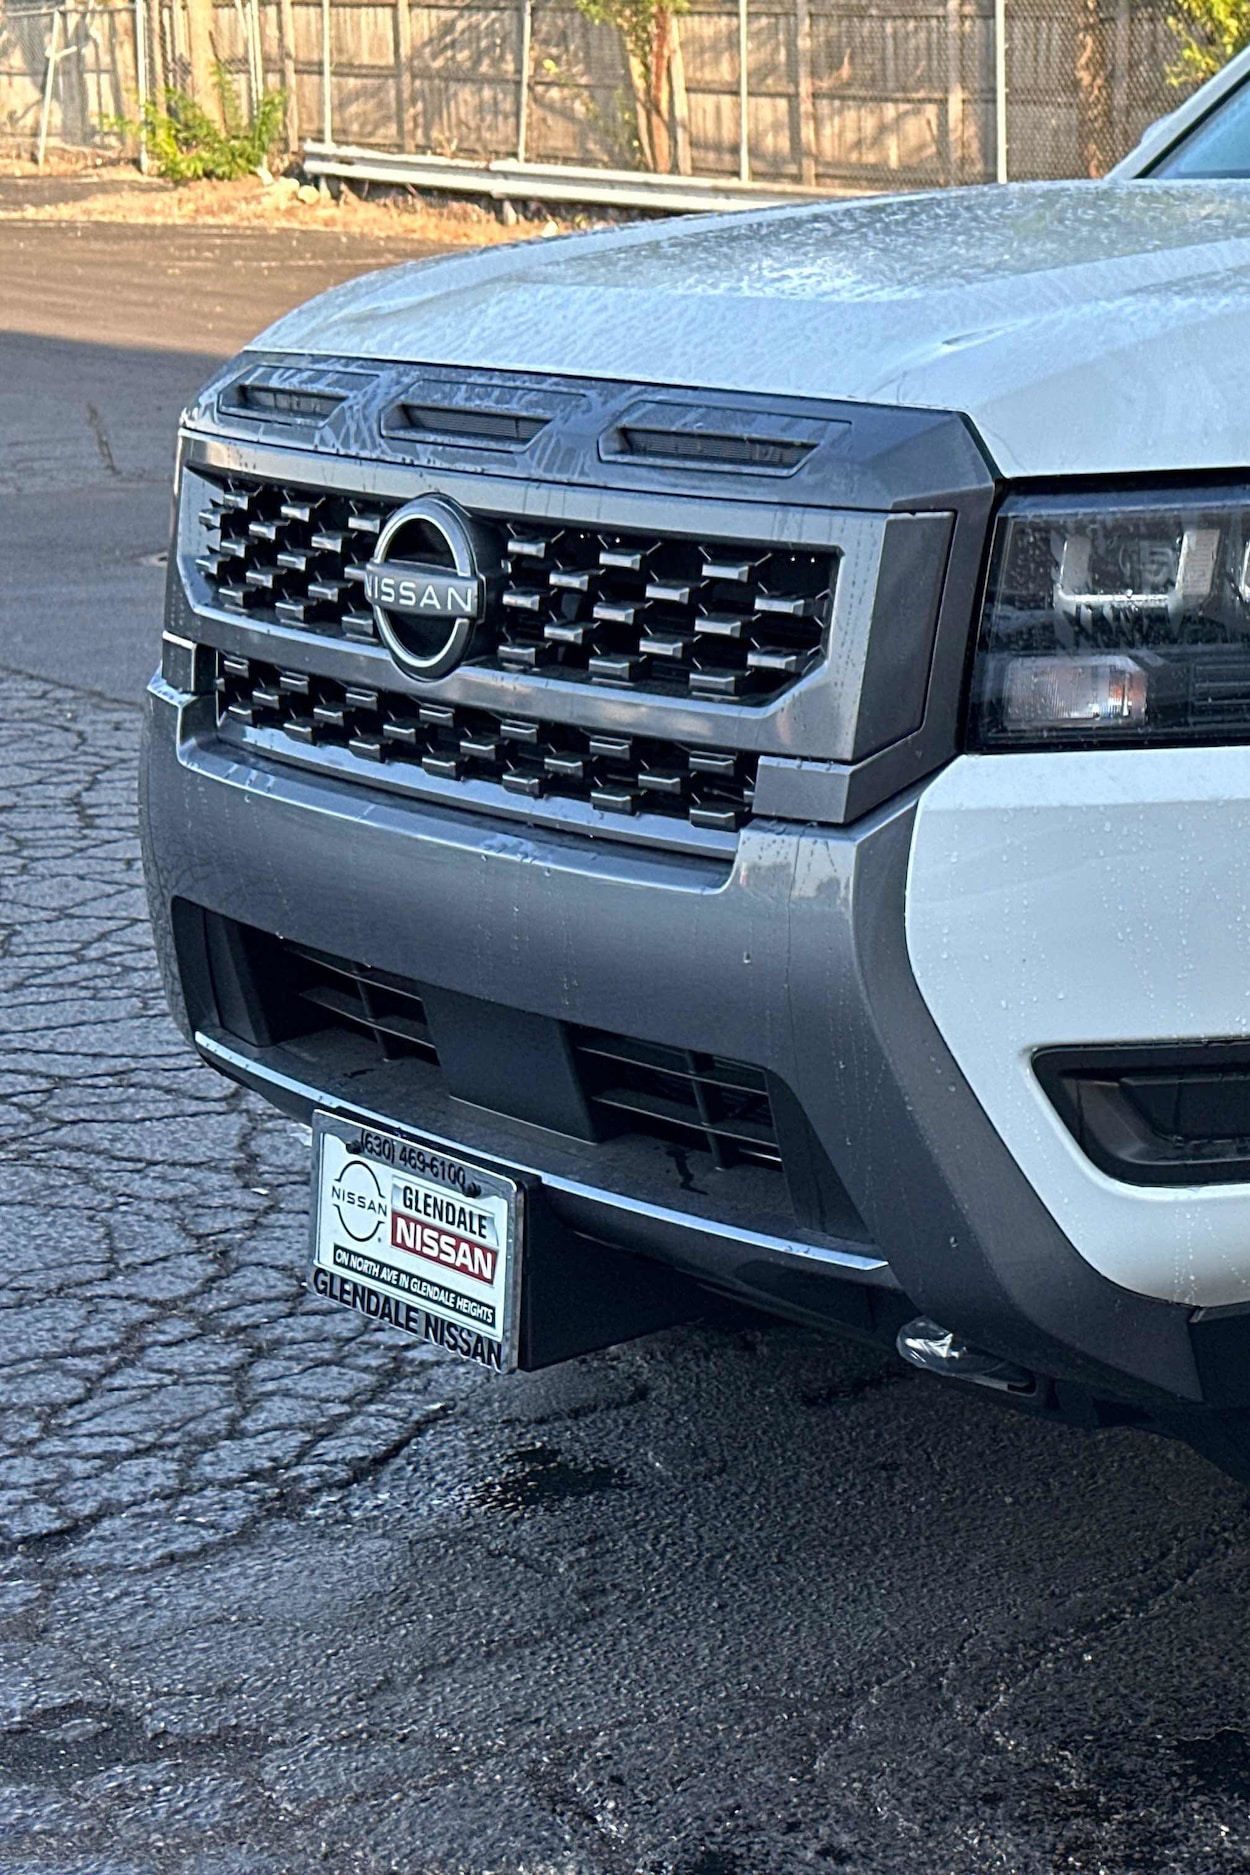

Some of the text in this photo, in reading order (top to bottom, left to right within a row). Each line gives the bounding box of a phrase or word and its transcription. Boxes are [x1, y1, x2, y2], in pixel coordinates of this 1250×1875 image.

[365, 576, 472, 612] NISSAN
[360, 1129, 467, 1190] (630) 469-6100
[331, 1185, 388, 1217] NISSAN
[402, 1185, 488, 1239] GLENDALE
[395, 1216, 493, 1280] NISSAN
[335, 1248, 494, 1322] ON NORTH AVE IN GLENDALE HEIGHTS
[313, 1267, 502, 1370] GLENDALE NISSAN
